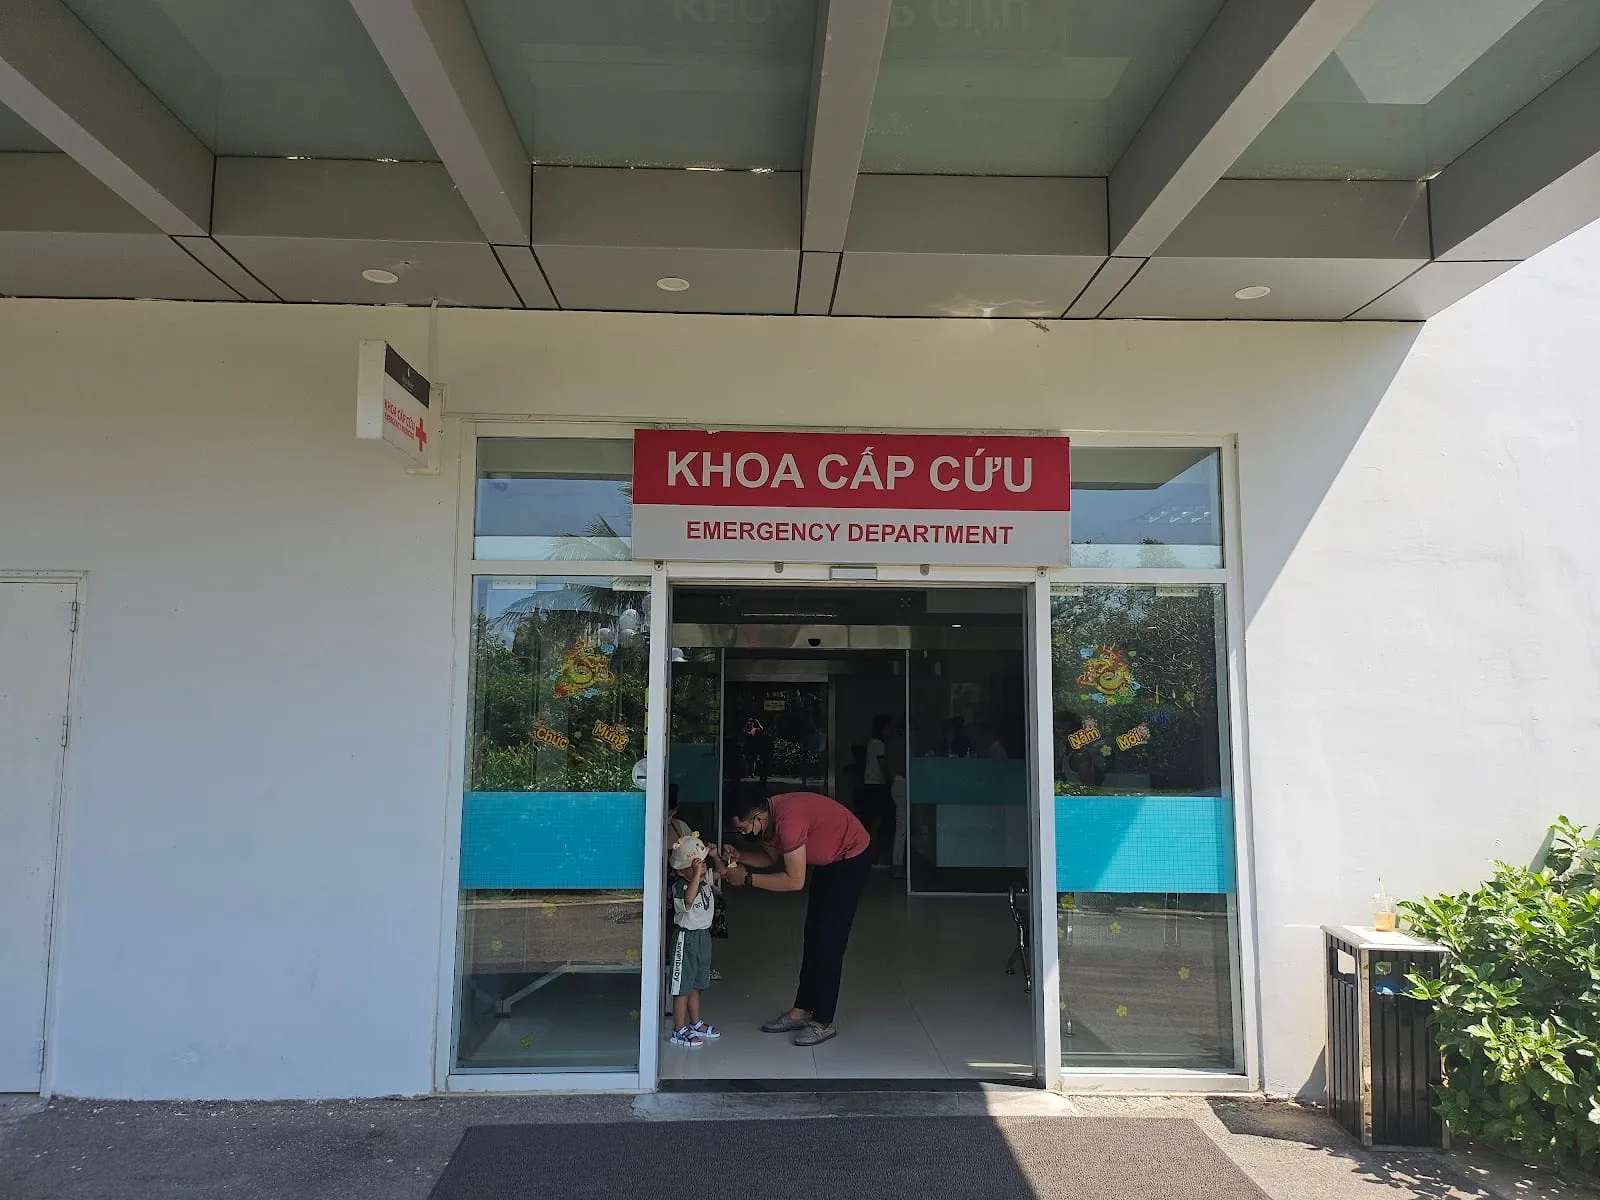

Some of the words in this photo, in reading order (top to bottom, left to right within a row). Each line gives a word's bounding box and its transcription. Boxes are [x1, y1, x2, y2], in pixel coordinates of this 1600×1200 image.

[667, 450, 804, 489] KHOA
[818, 446, 915, 490] CẤP
[929, 448, 1033, 493] CỨU
[687, 521, 841, 542] EMERGENCY
[848, 523, 1014, 545] DEPARTMENT
